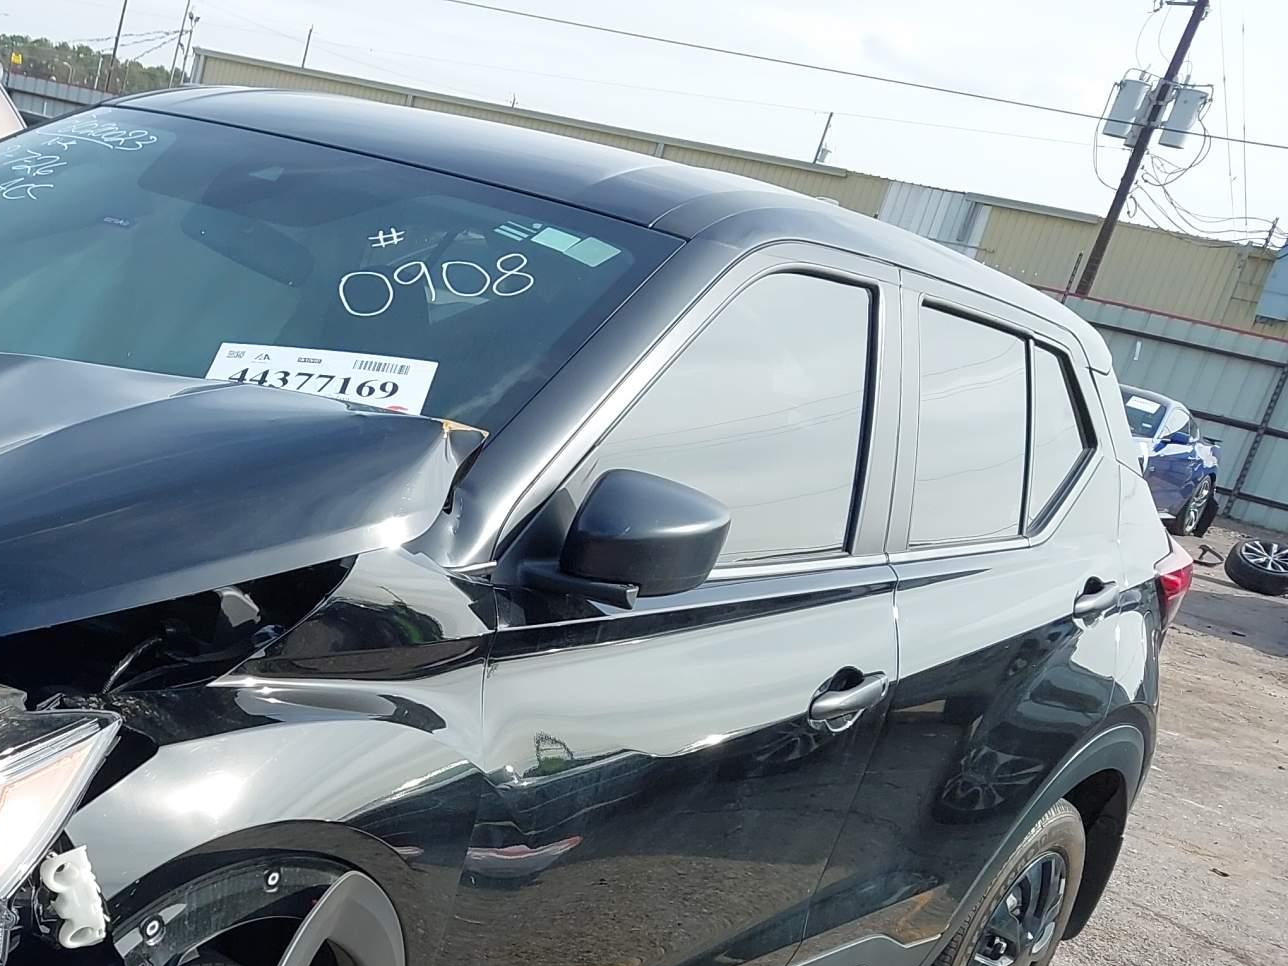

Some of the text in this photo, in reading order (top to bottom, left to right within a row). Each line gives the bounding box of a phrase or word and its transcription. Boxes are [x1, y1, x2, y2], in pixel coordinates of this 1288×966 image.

[368, 227, 405, 247] #
[339, 253, 534, 316] 0908
[228, 367, 400, 399] 44377169
